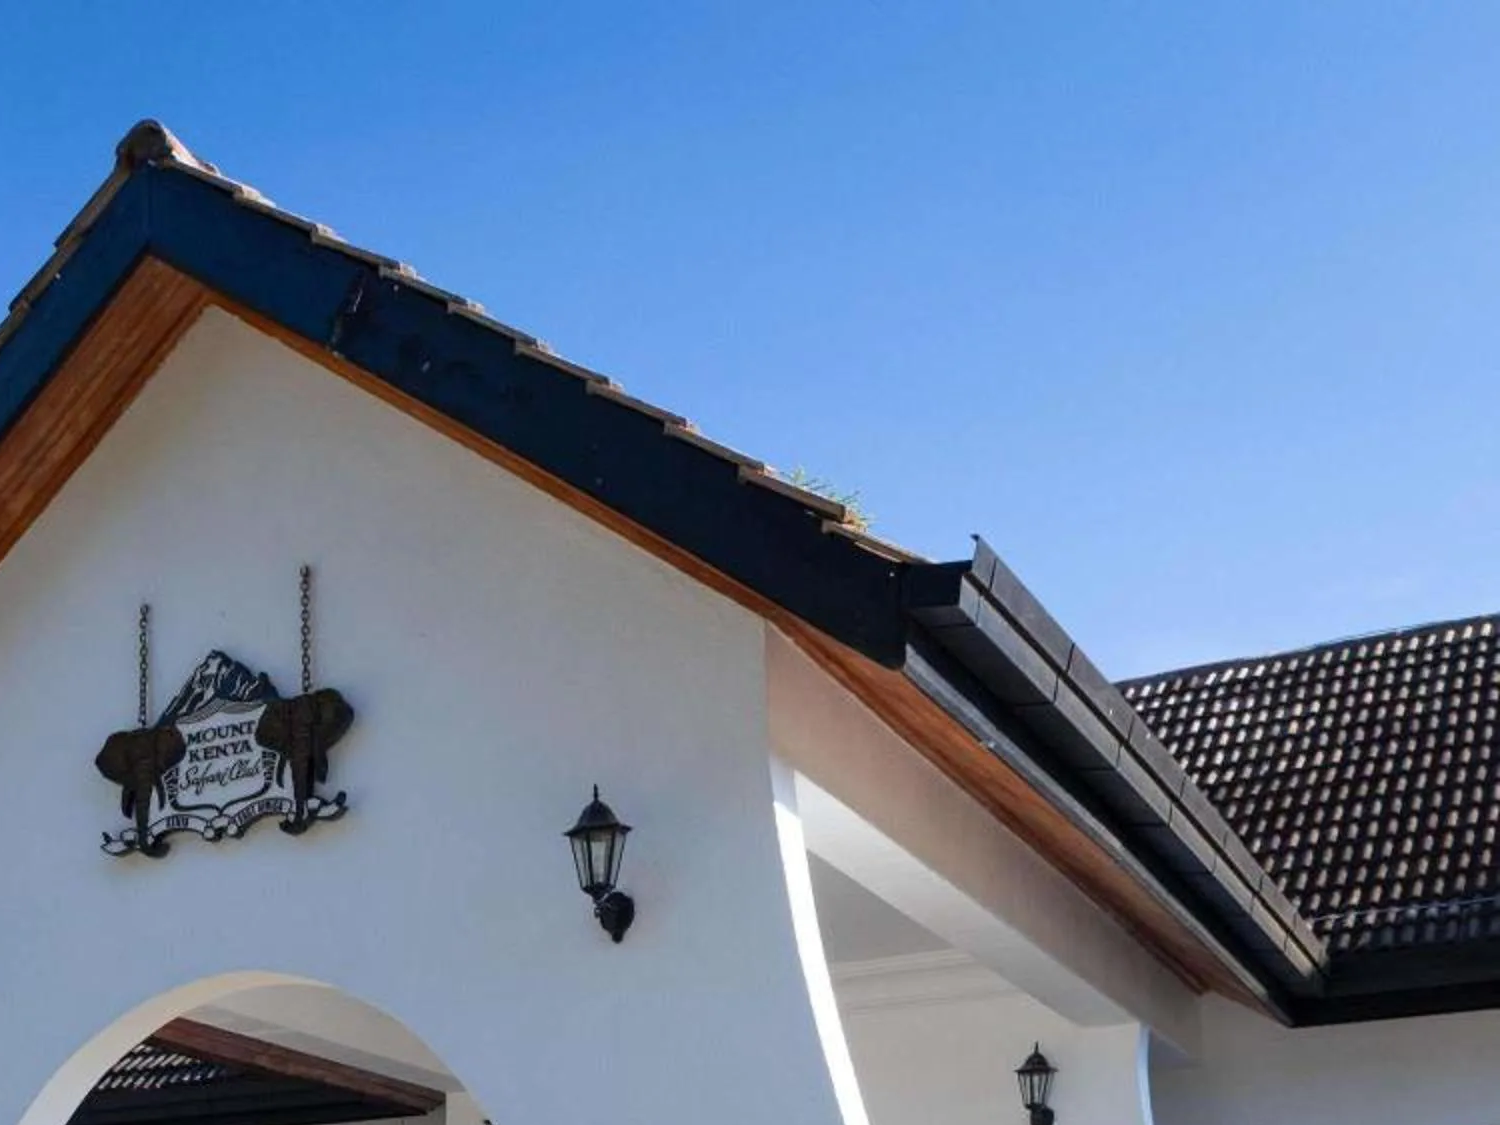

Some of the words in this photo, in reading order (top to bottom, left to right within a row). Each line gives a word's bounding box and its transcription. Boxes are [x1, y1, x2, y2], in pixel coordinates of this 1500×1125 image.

[187, 720, 256, 745] MOUNT
[189, 740, 253, 762] KENYA
[180, 762, 229, 796] Safari
